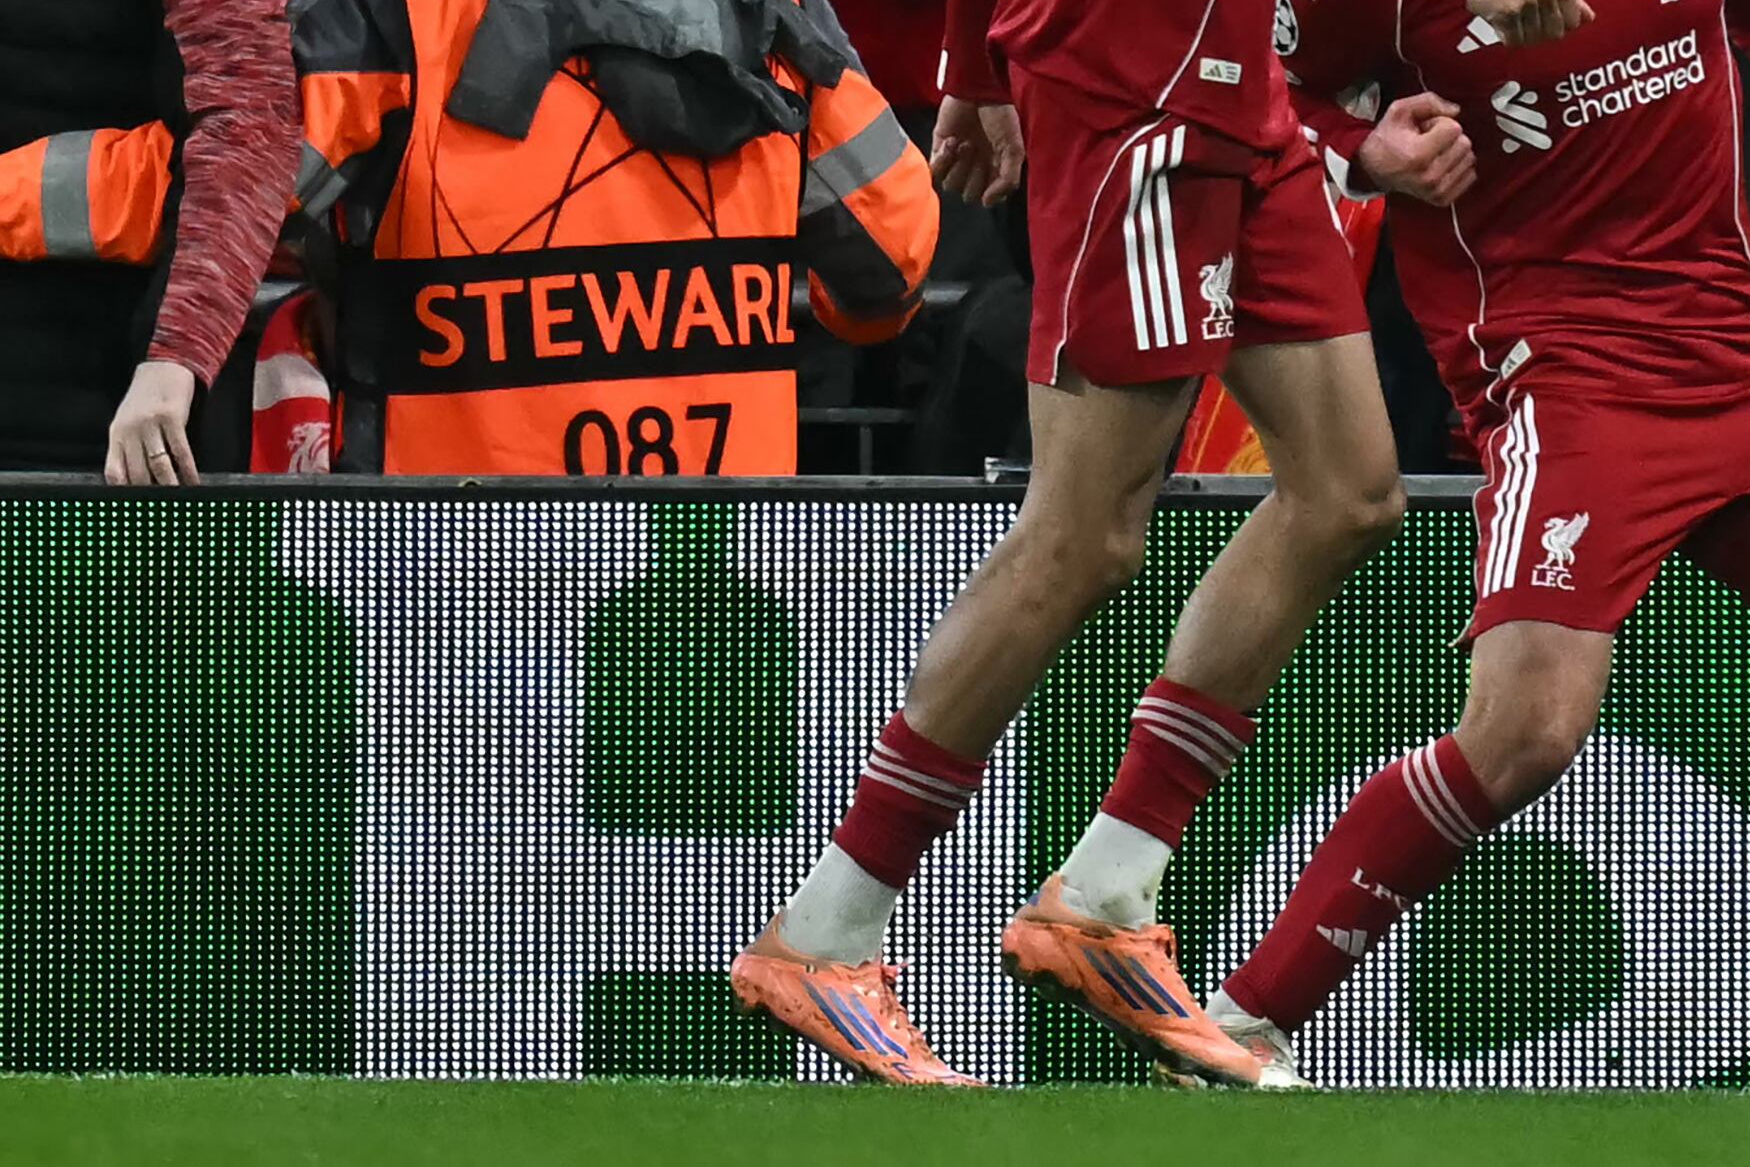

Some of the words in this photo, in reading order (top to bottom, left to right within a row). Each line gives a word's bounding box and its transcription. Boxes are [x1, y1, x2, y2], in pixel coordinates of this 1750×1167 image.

[1555, 29, 1697, 102] standard
[1563, 54, 1705, 128] chartered
[564, 402, 732, 476] 087
